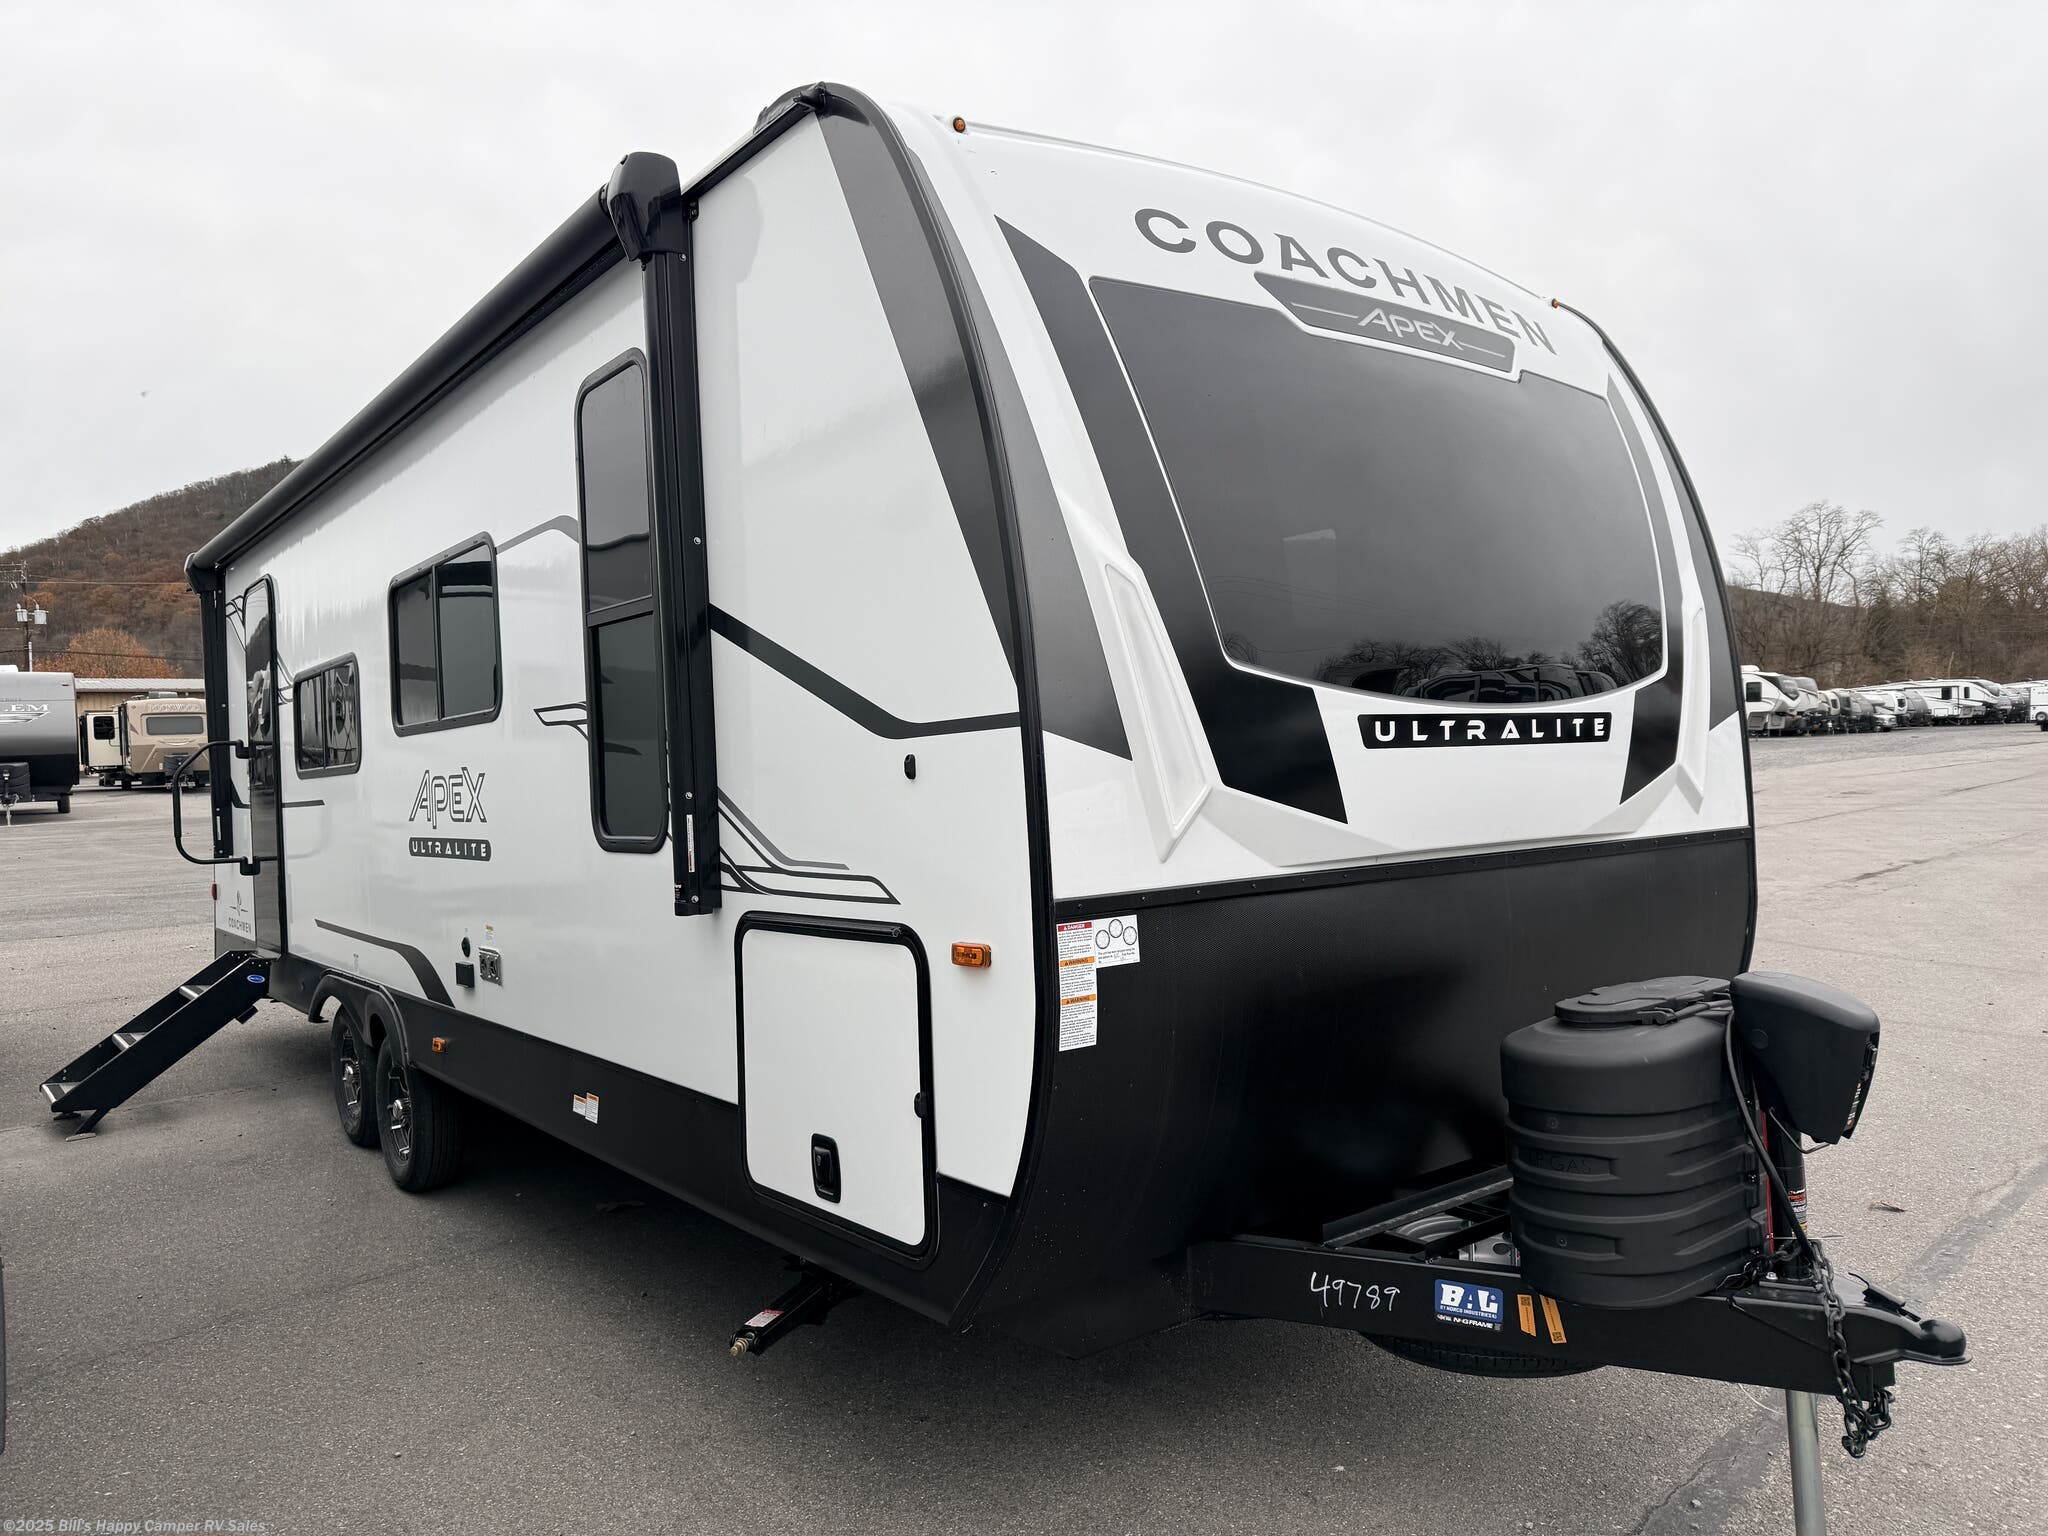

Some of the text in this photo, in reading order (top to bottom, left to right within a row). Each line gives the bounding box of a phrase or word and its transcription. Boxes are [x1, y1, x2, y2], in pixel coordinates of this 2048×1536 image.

[1134, 208, 1558, 355] COACHMEN
[1358, 307, 1464, 350] APEX
[1374, 718, 1605, 742] ULTRALITE
[409, 767, 488, 829] APEX
[412, 841, 487, 857] ULTRALITE
[1551, 1155, 1593, 1174] GAS
[1310, 1271, 1401, 1312] 49789
